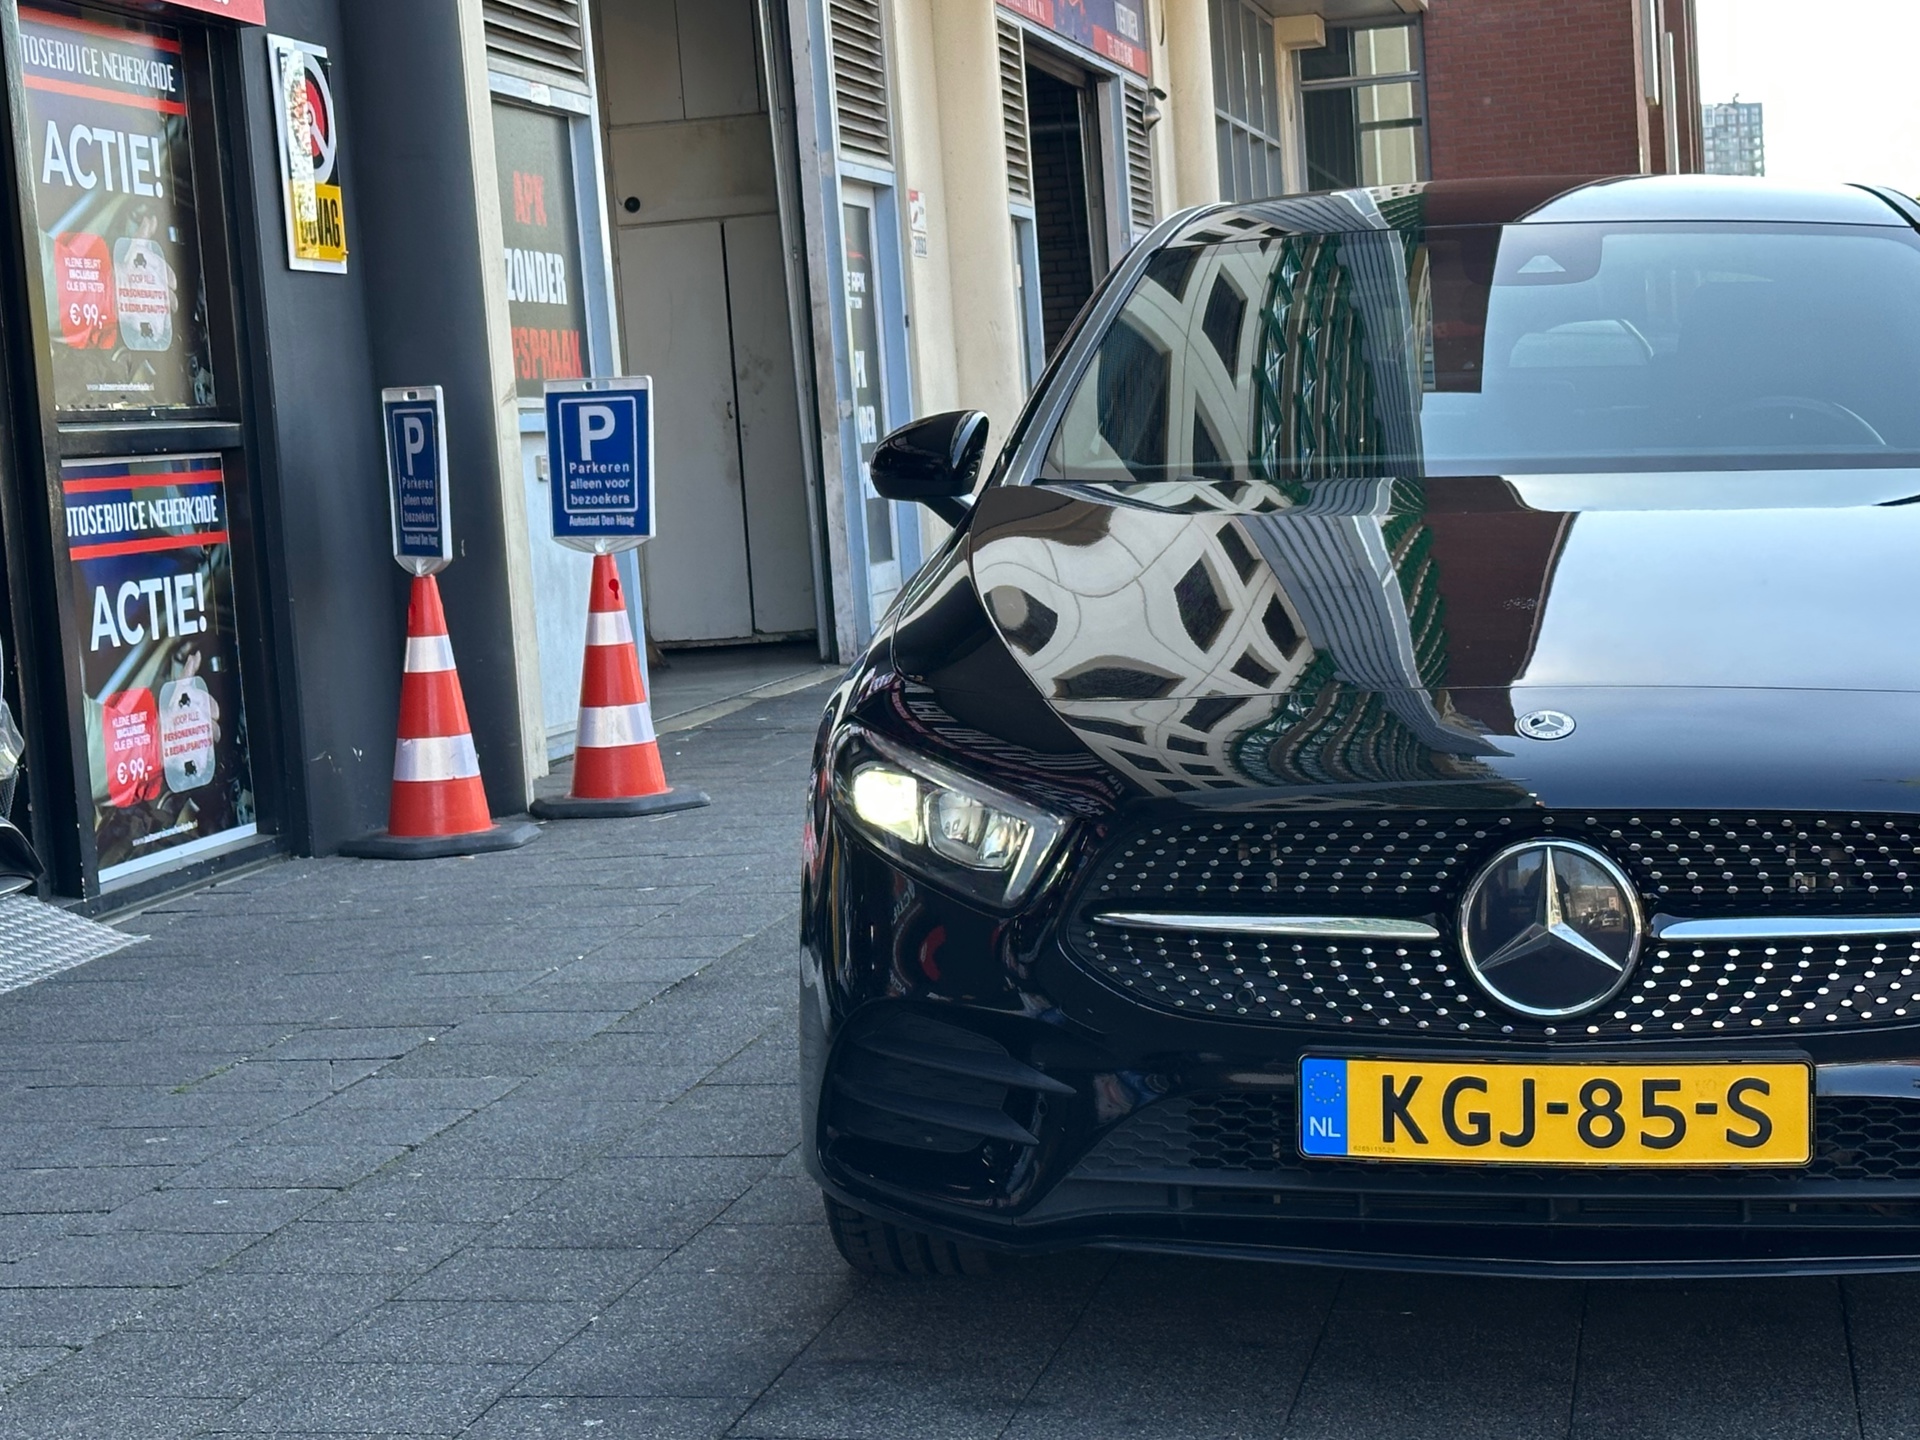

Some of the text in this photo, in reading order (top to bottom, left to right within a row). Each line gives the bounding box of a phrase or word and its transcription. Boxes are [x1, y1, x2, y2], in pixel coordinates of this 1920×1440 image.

[20, 34, 176, 92] TOSERVICE NEHERKADE
[42, 119, 164, 199] ACTIE!
[513, 171, 547, 227] APK
[504, 248, 568, 305] ZONDER
[83, 303, 107, 329] 99,-
[404, 417, 425, 476] P
[579, 405, 616, 461] P
[569, 462, 630, 475] Parkeren
[402, 477, 434, 490] Parkeren
[570, 478, 630, 490] alleen voor
[148, 495, 219, 529] NEHERKADE
[404, 494, 434, 506] alleen voor
[570, 493, 630, 506] bezoekers
[404, 510, 435, 523] bezoekers
[569, 515, 635, 528] Autostad Den Haag
[90, 572, 207, 652] ACTIE!
[117, 757, 153, 784] € 99,-
[1381, 1075, 1773, 1150] KGJ-85-S
[1309, 1116, 1341, 1139] NL
